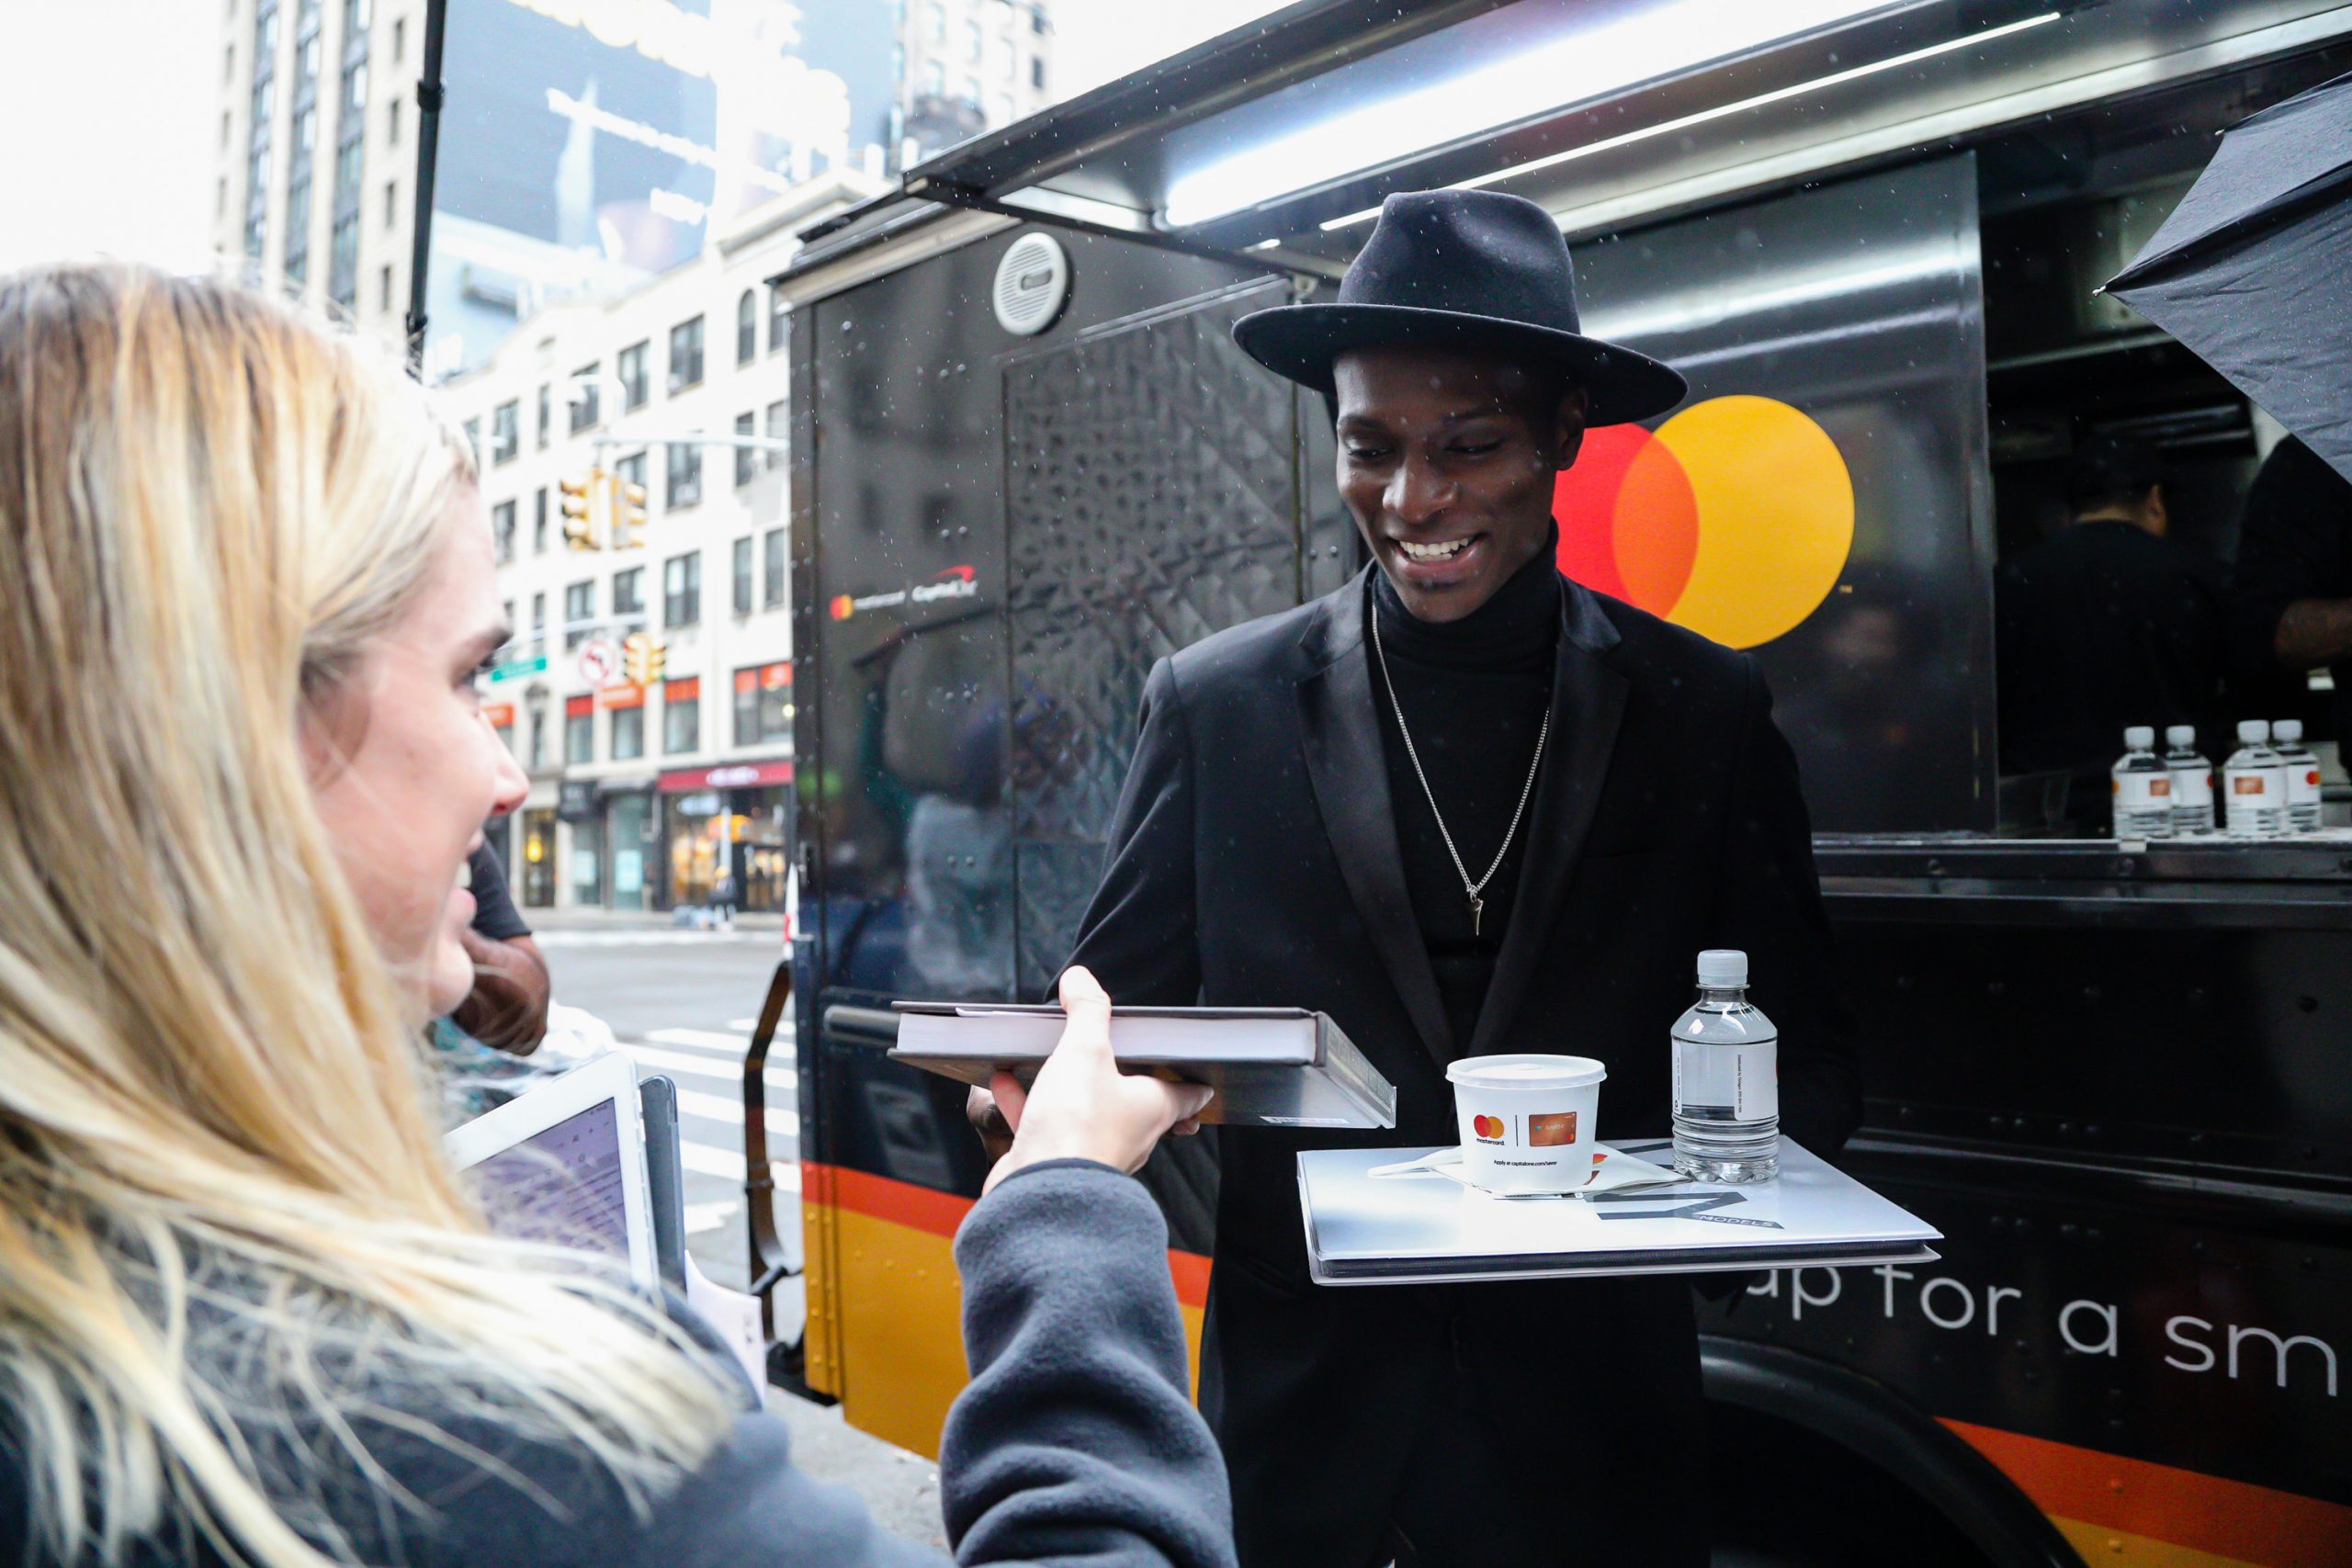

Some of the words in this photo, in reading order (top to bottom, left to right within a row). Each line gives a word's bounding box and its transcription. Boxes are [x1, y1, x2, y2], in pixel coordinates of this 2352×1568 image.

[1700, 1214, 1774, 1227] MODELS
[1872, 1264, 2021, 1337] for
[2058, 1299, 2118, 1358] a
[2164, 1314, 2337, 1397] sm
